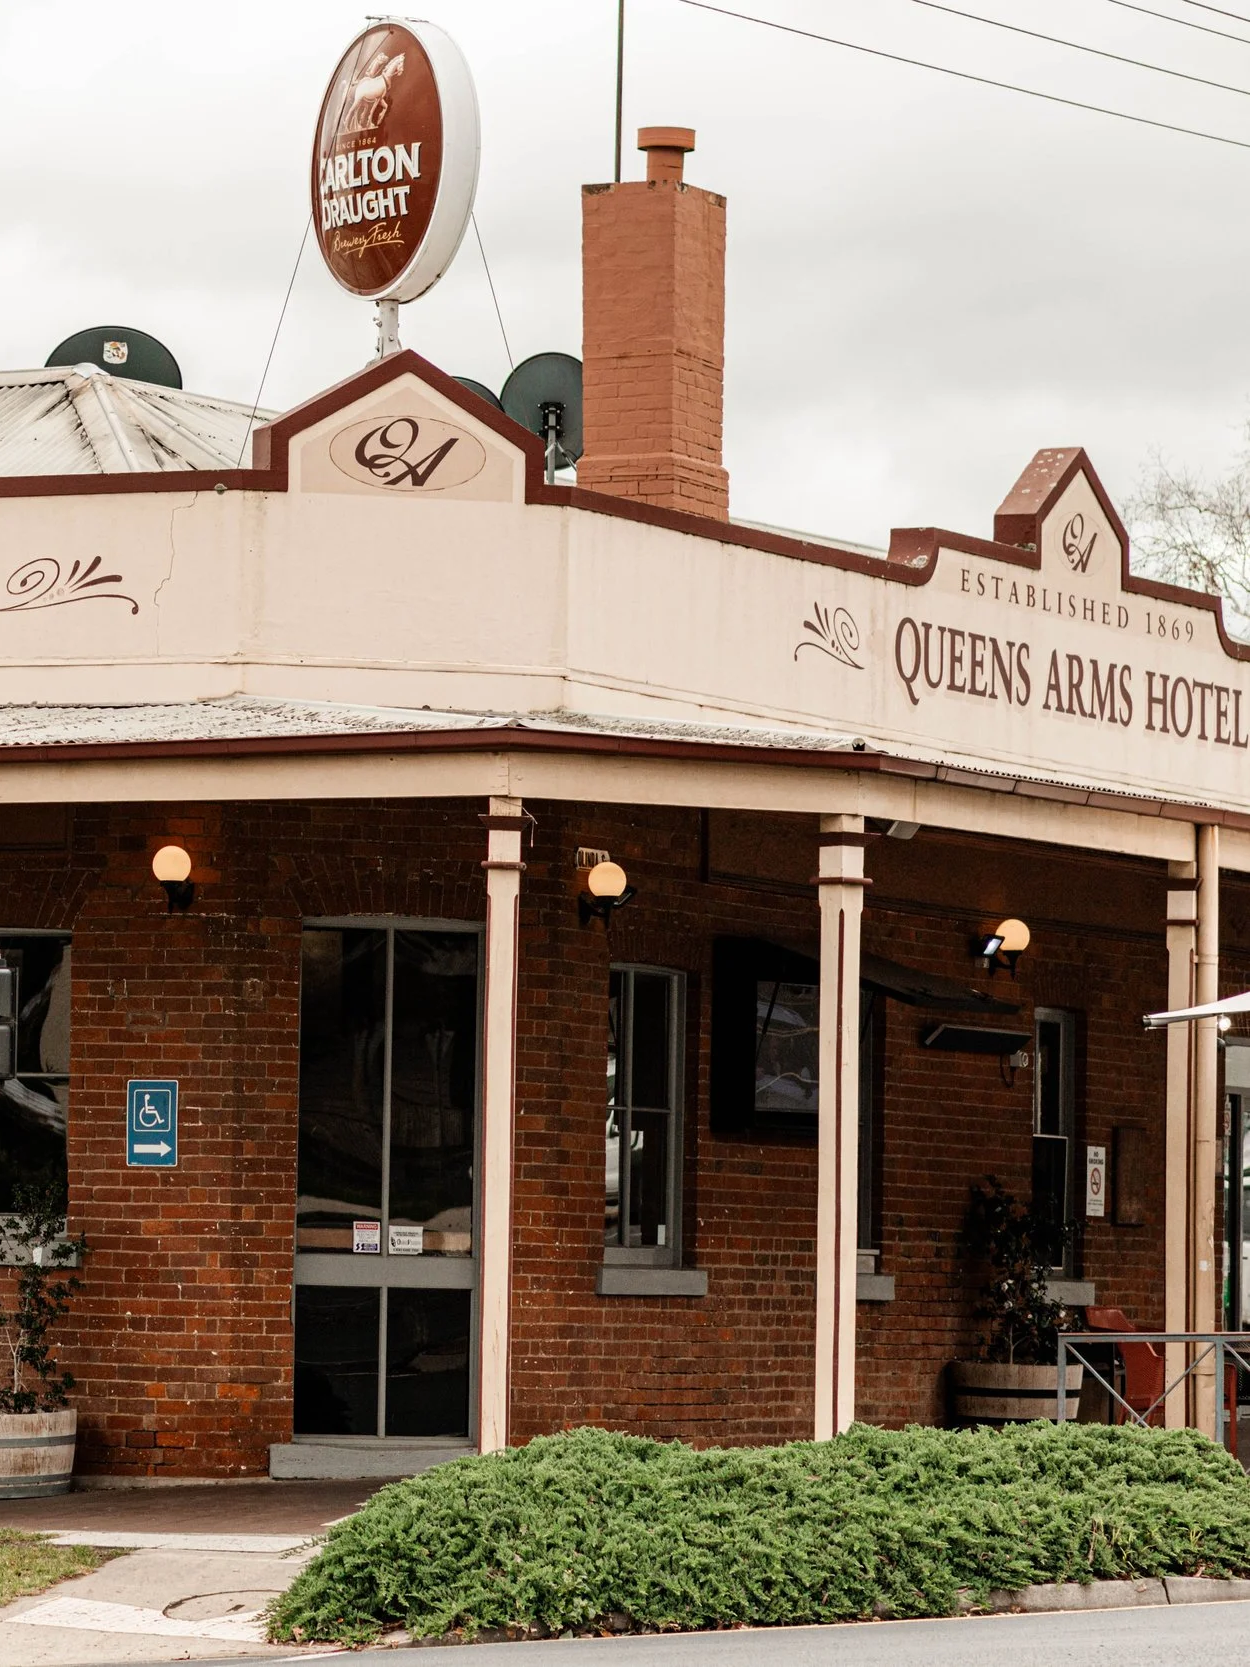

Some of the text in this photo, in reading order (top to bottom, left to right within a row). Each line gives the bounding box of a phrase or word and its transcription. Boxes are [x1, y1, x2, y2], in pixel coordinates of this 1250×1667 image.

[358, 136, 377, 147] 1864
[321, 185, 410, 231] DRAUGHT
[333, 220, 403, 258] Brewery Fresh
[960, 568, 1194, 643] ESTABLISHED 1869
[894, 616, 1249, 749] QUEENS ARMS HOTEL
